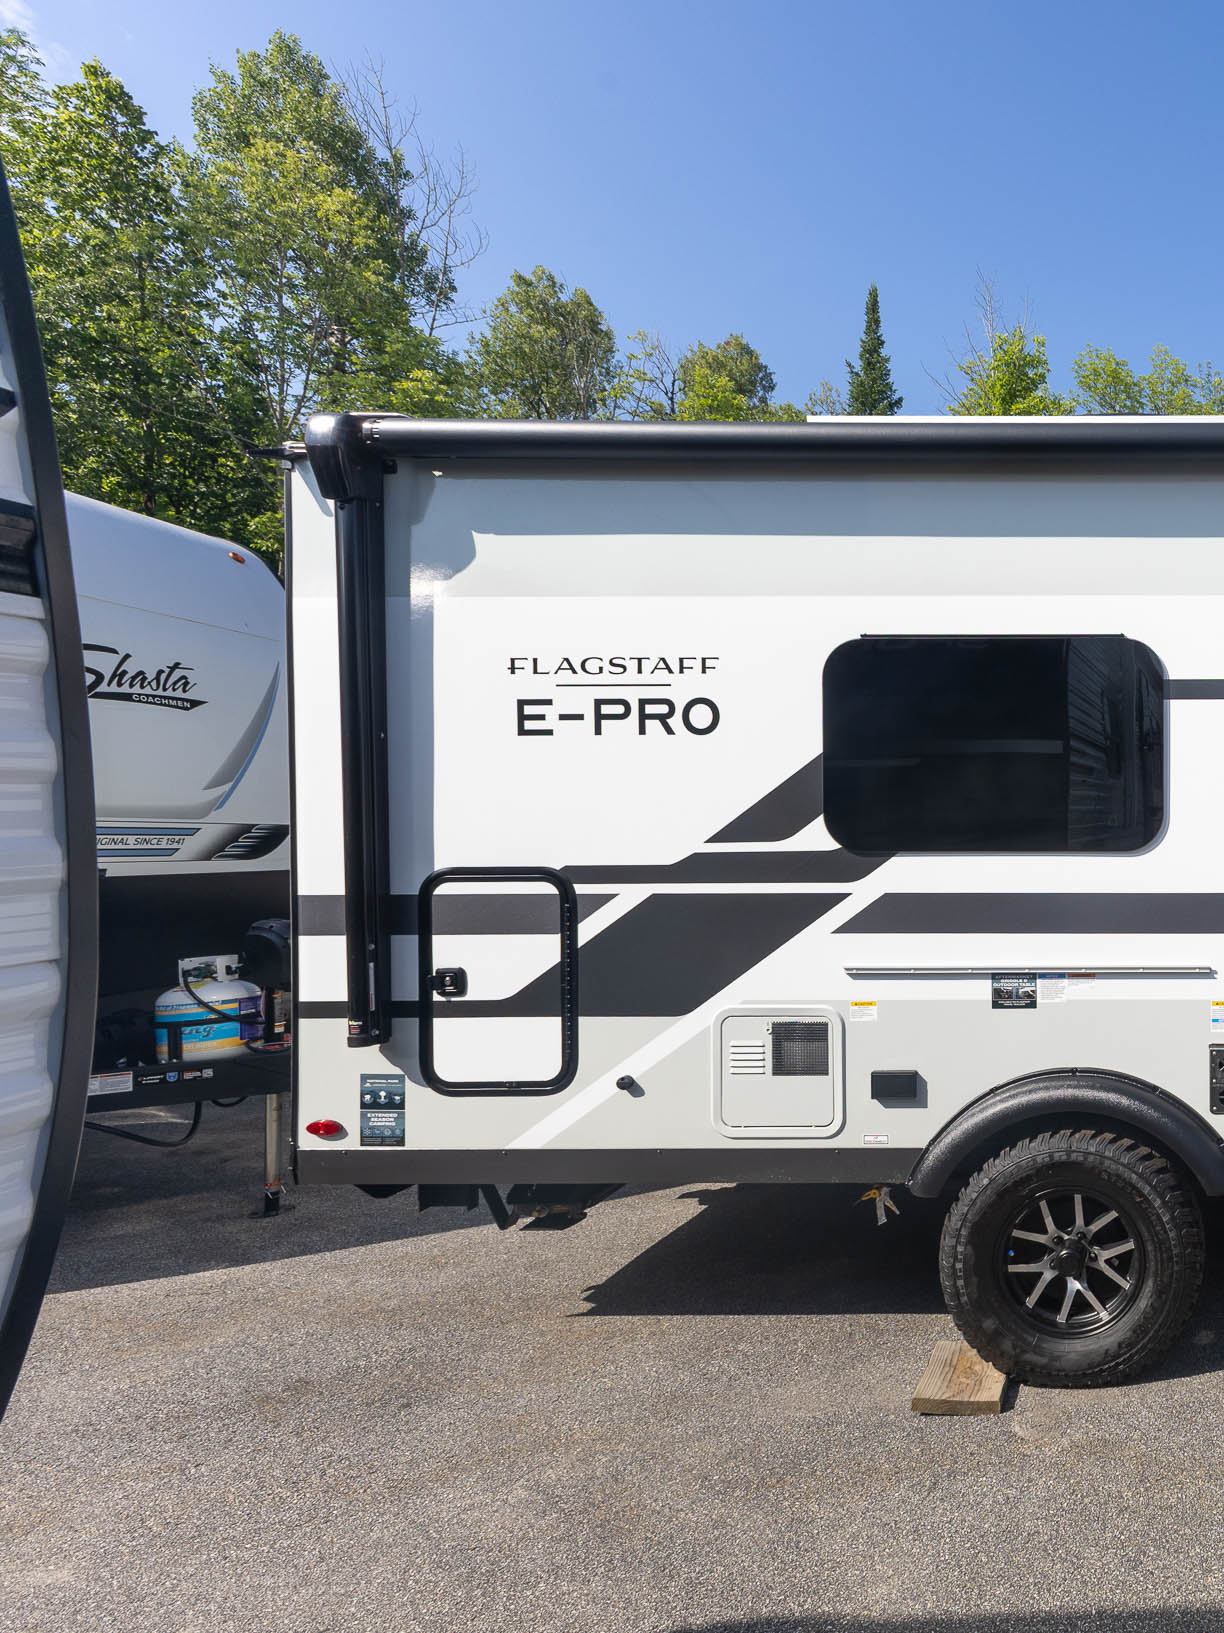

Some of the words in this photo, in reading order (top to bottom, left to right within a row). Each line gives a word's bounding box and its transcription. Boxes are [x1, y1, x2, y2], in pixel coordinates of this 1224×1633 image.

[82, 643, 197, 696] Shasta
[507, 656, 719, 675] FLAGSTAFF
[132, 694, 191, 708] COACHMEN
[516, 697, 720, 736] E-PRO
[133, 837, 164, 846] SINCE
[165, 837, 186, 846] 1941
